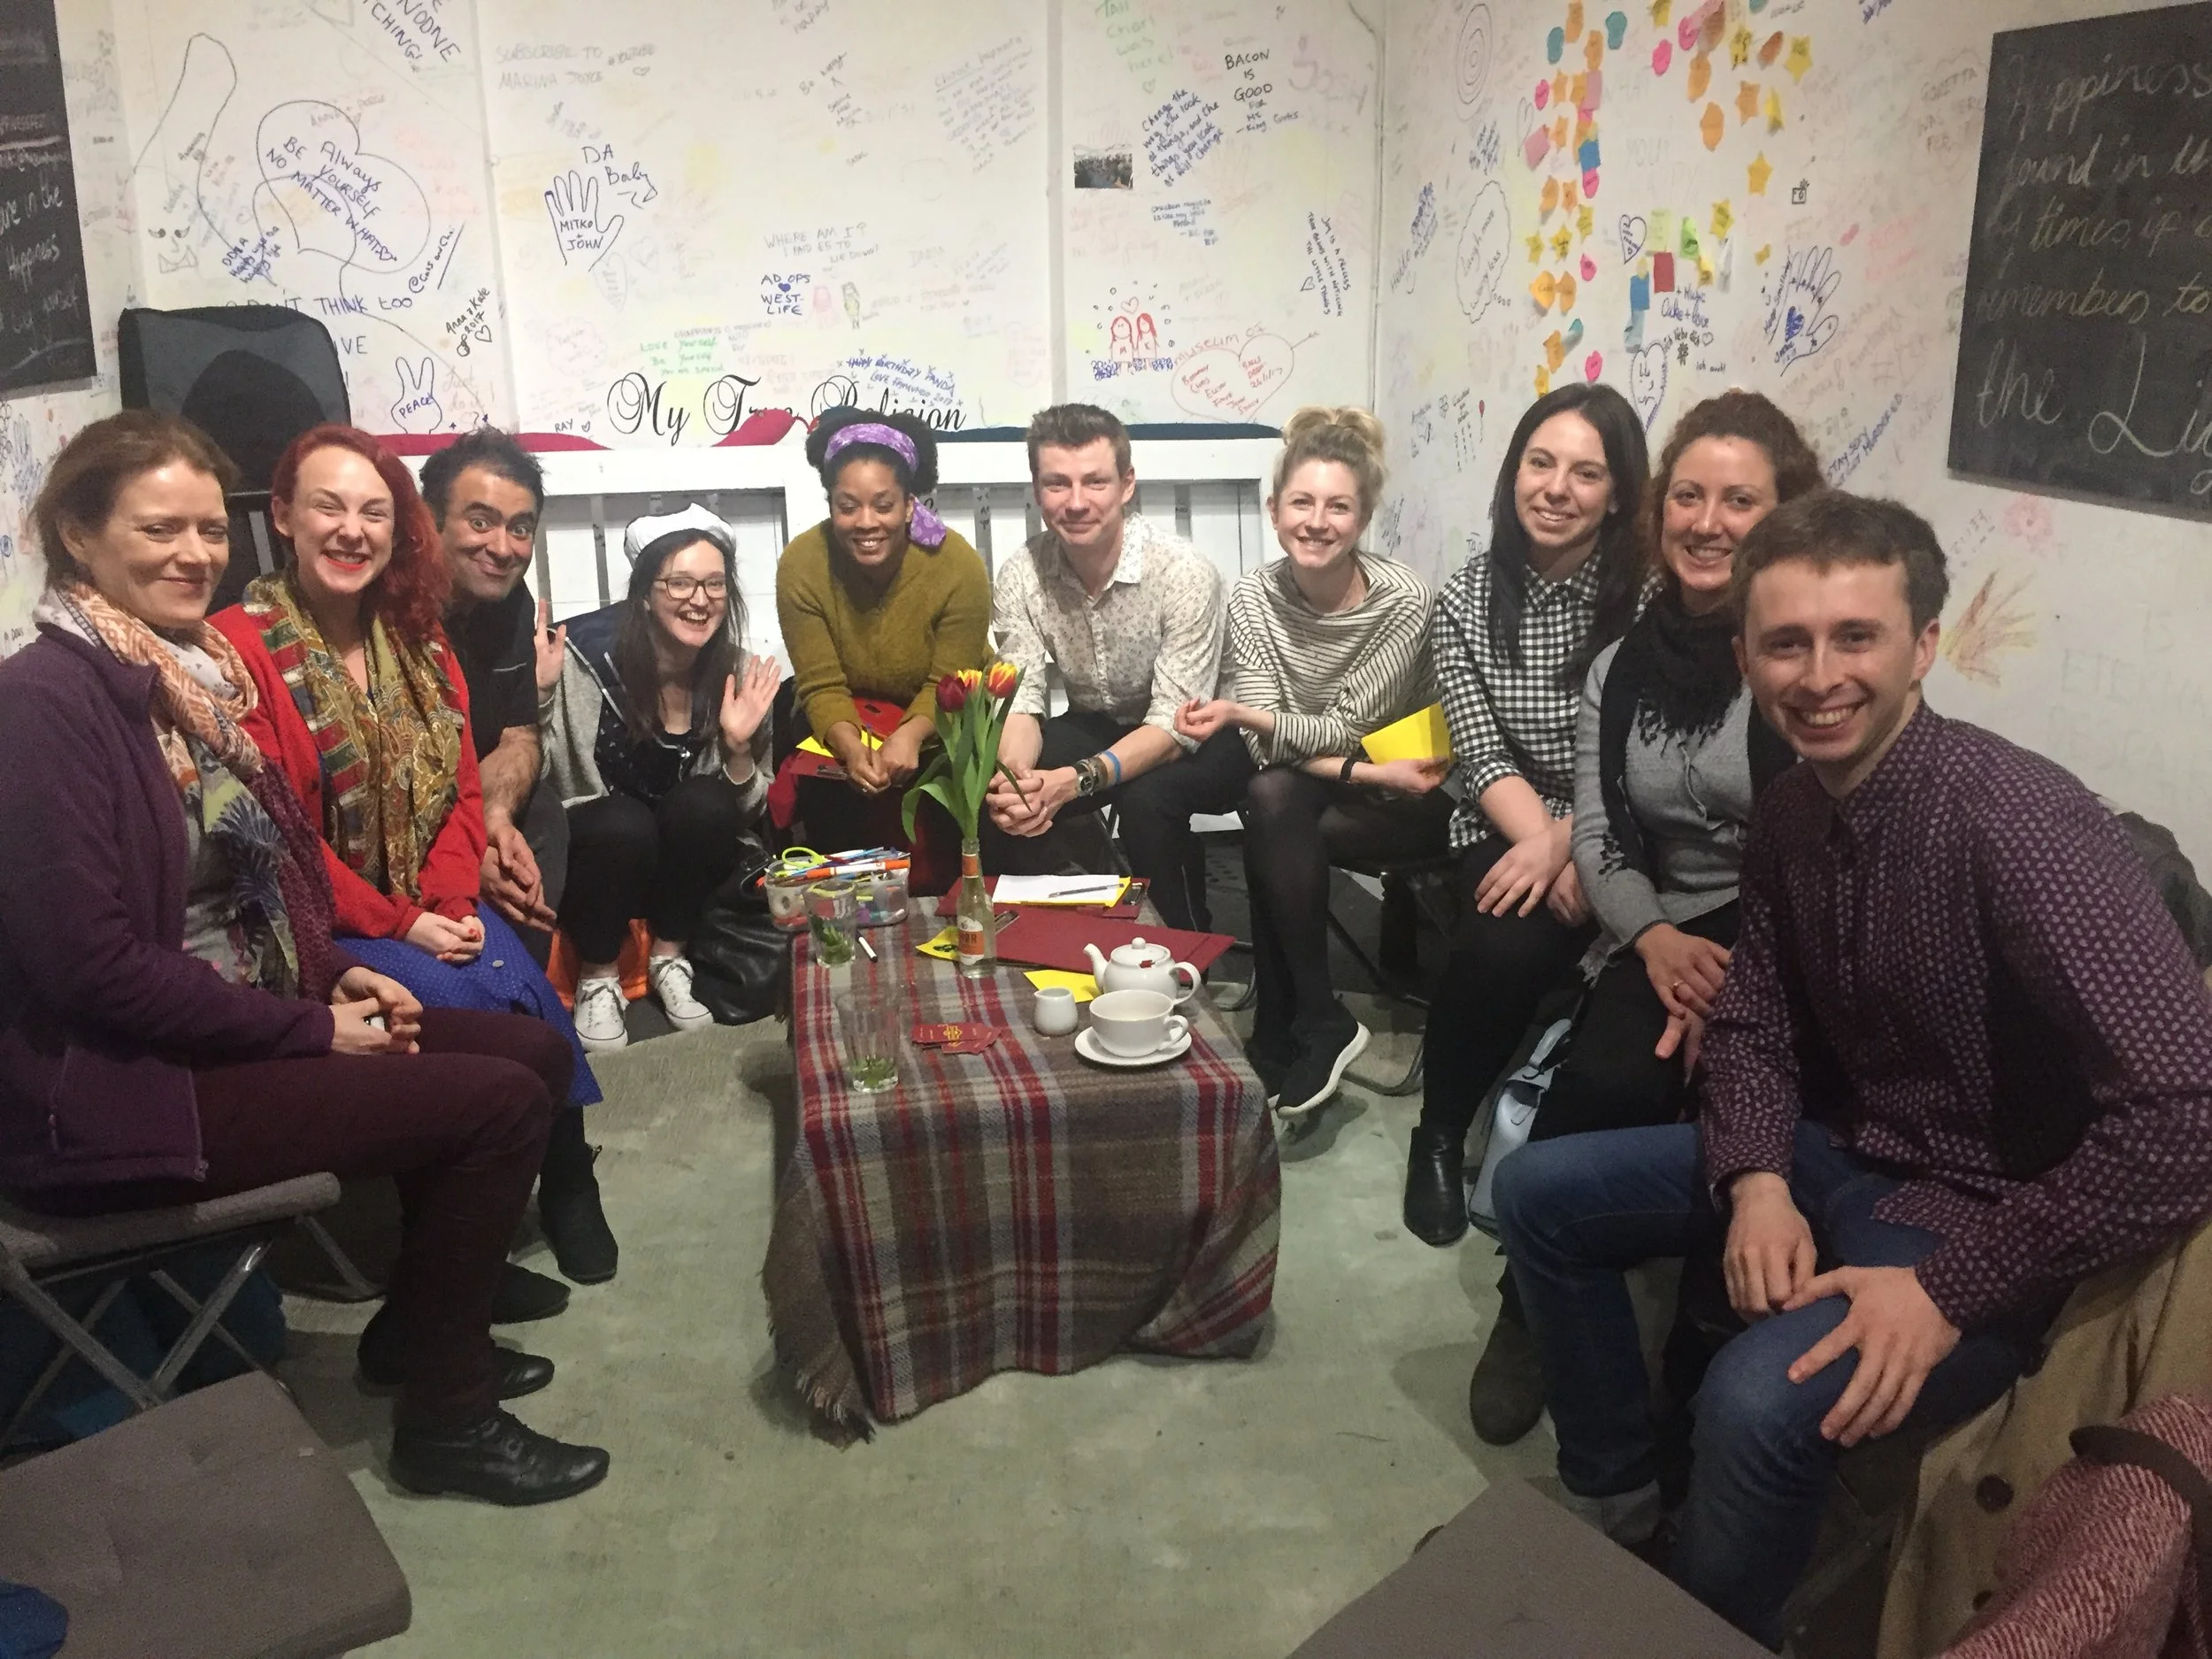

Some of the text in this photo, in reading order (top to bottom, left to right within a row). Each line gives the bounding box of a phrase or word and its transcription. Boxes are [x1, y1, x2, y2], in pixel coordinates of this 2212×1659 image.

[495, 43, 577, 64] SUBSCRIBE
[582, 46, 603, 59] TO
[1225, 49, 1271, 70] BACON
[498, 71, 603, 89] MARINA JOYCE
[1244, 68, 1255, 81] IS
[1180, 92, 1201, 113] look
[1233, 83, 1272, 102] GOOD
[1141, 88, 1187, 132] Change the
[1202, 102, 1219, 117] the
[581, 143, 613, 164] DA
[283, 136, 382, 194] BE Always
[265, 148, 288, 169] NO
[290, 170, 342, 216] MATTER
[604, 161, 657, 196] Baby
[311, 165, 381, 219] YOURSELF
[559, 219, 593, 233] MITKO
[566, 236, 603, 251] JOHN
[764, 231, 806, 249] WHERE
[817, 227, 836, 239] AM
[835, 240, 850, 249] TO
[1324, 256, 1334, 277] WITH
[1338, 258, 1351, 290] PROCESS
[761, 273, 810, 285] AD OPS
[313, 295, 368, 315] THINK
[470, 286, 490, 311] Kate
[2162, 272, 2210, 317] to
[766, 305, 803, 316] LIFE
[465, 311, 486, 334] 2017
[640, 342, 668, 352] LOVE
[871, 370, 888, 384] LOVE
[875, 357, 922, 379] BIRTHDAY
[1976, 338, 2062, 428] the
[607, 372, 690, 447] My
[810, 375, 967, 431] Rliion
[554, 419, 573, 432] RAY
